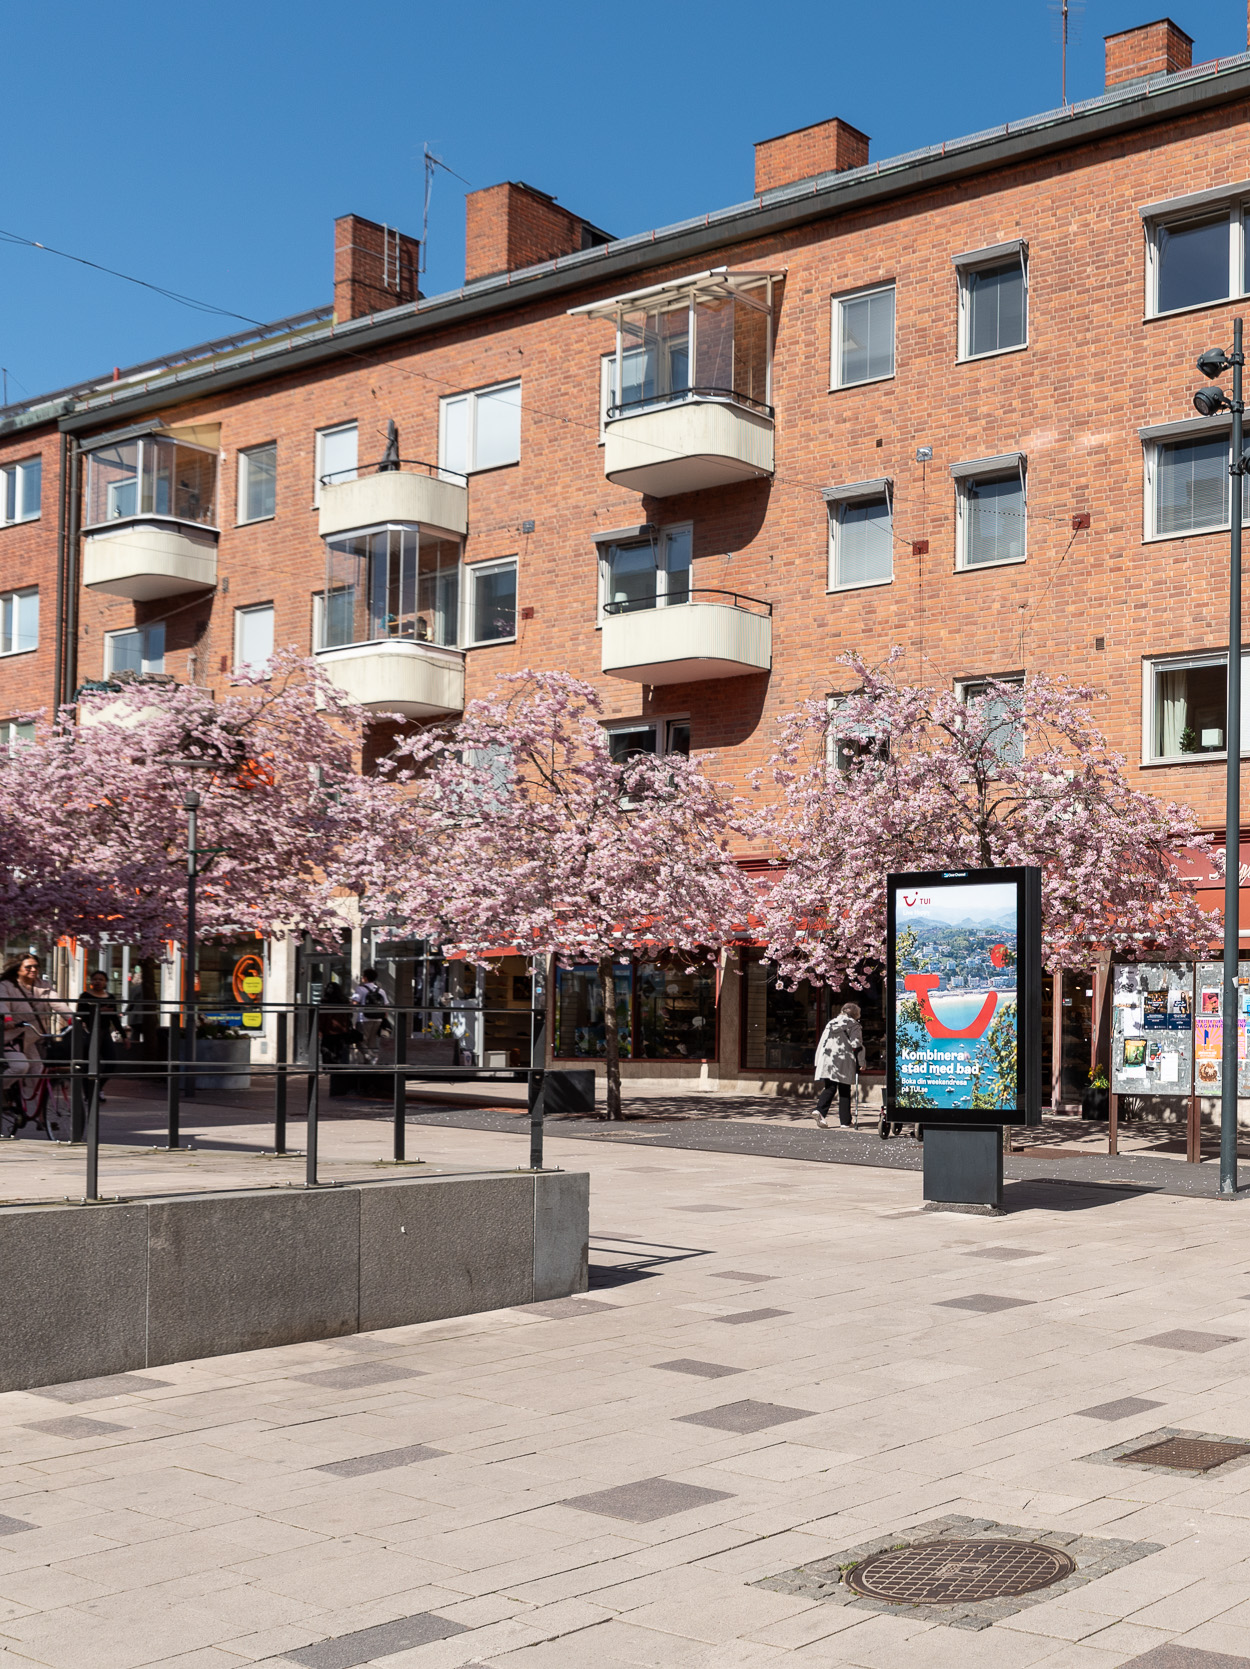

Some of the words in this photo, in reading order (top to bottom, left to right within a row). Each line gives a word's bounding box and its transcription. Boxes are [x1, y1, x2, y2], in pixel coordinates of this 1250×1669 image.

[901, 1048, 965, 1061] Kombinera
[901, 1062, 927, 1074] stad
[929, 1062, 954, 1074] med
[956, 1062, 980, 1075] bad
[901, 1077, 916, 1085] Boka
[926, 1078, 968, 1086] weekendresa
[901, 1085, 909, 1094] på
[909, 1085, 929, 1093] TUI.se
